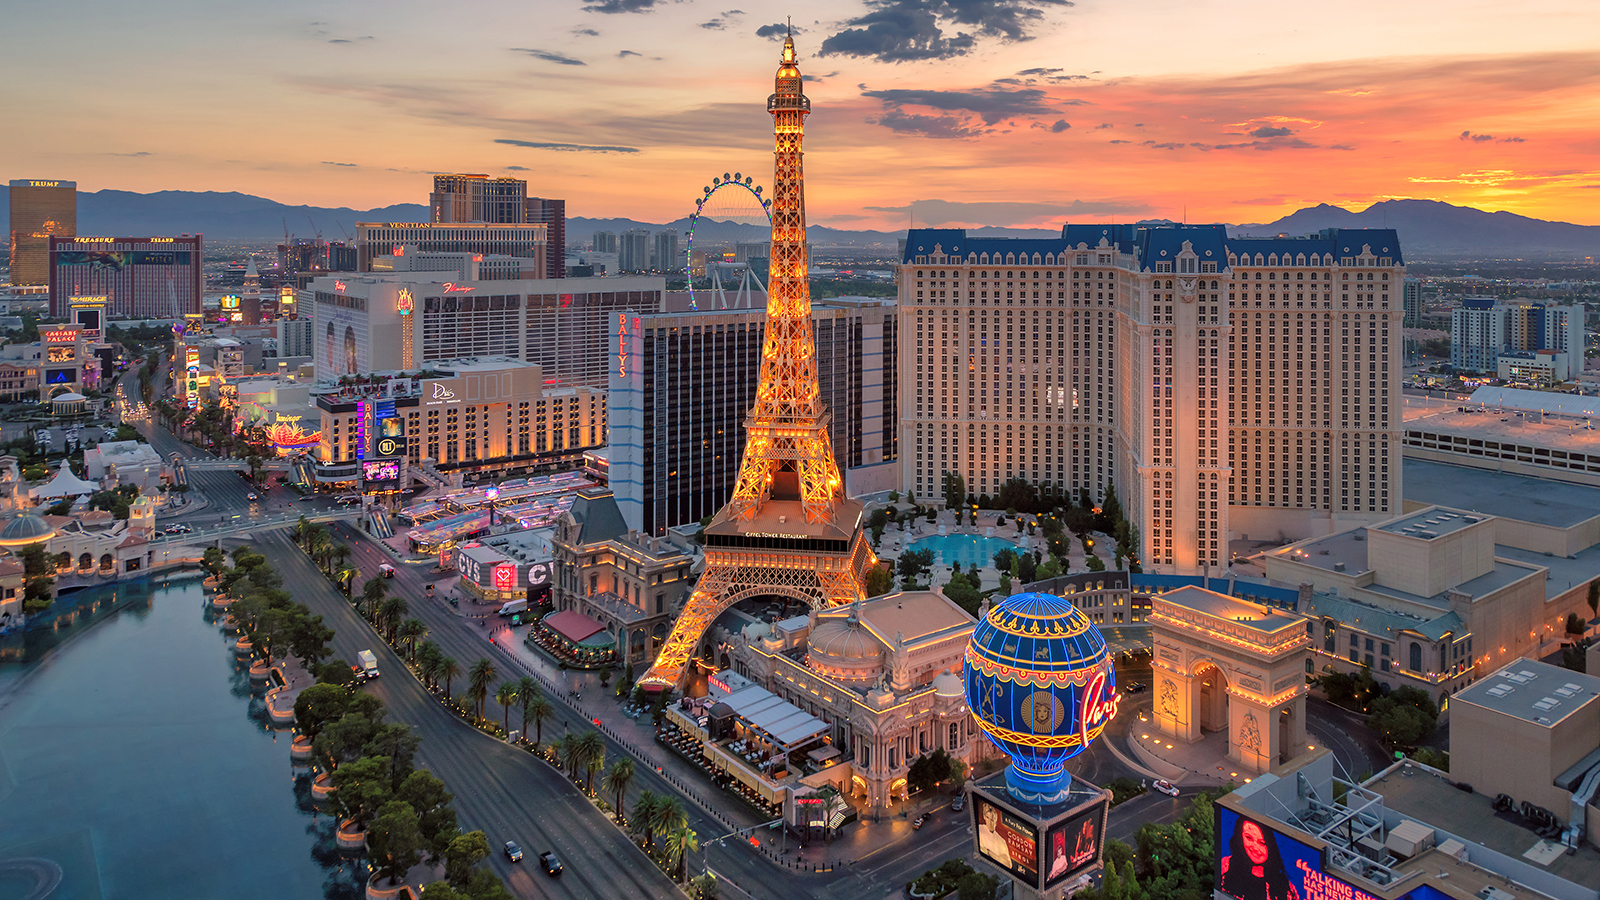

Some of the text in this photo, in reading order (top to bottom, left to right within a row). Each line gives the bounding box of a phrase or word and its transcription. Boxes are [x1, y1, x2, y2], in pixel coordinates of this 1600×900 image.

[617, 314, 628, 378] BALLYS
[364, 403, 373, 453] BALLYS
[458, 552, 480, 583] CVS
[707, 674, 732, 694] BEER PARK
[1080, 670, 1122, 748] Paris
[1007, 831, 1033, 850] GORDON
[1007, 838, 1033, 856] RAMSAY
[1303, 876, 1324, 893] HAS
